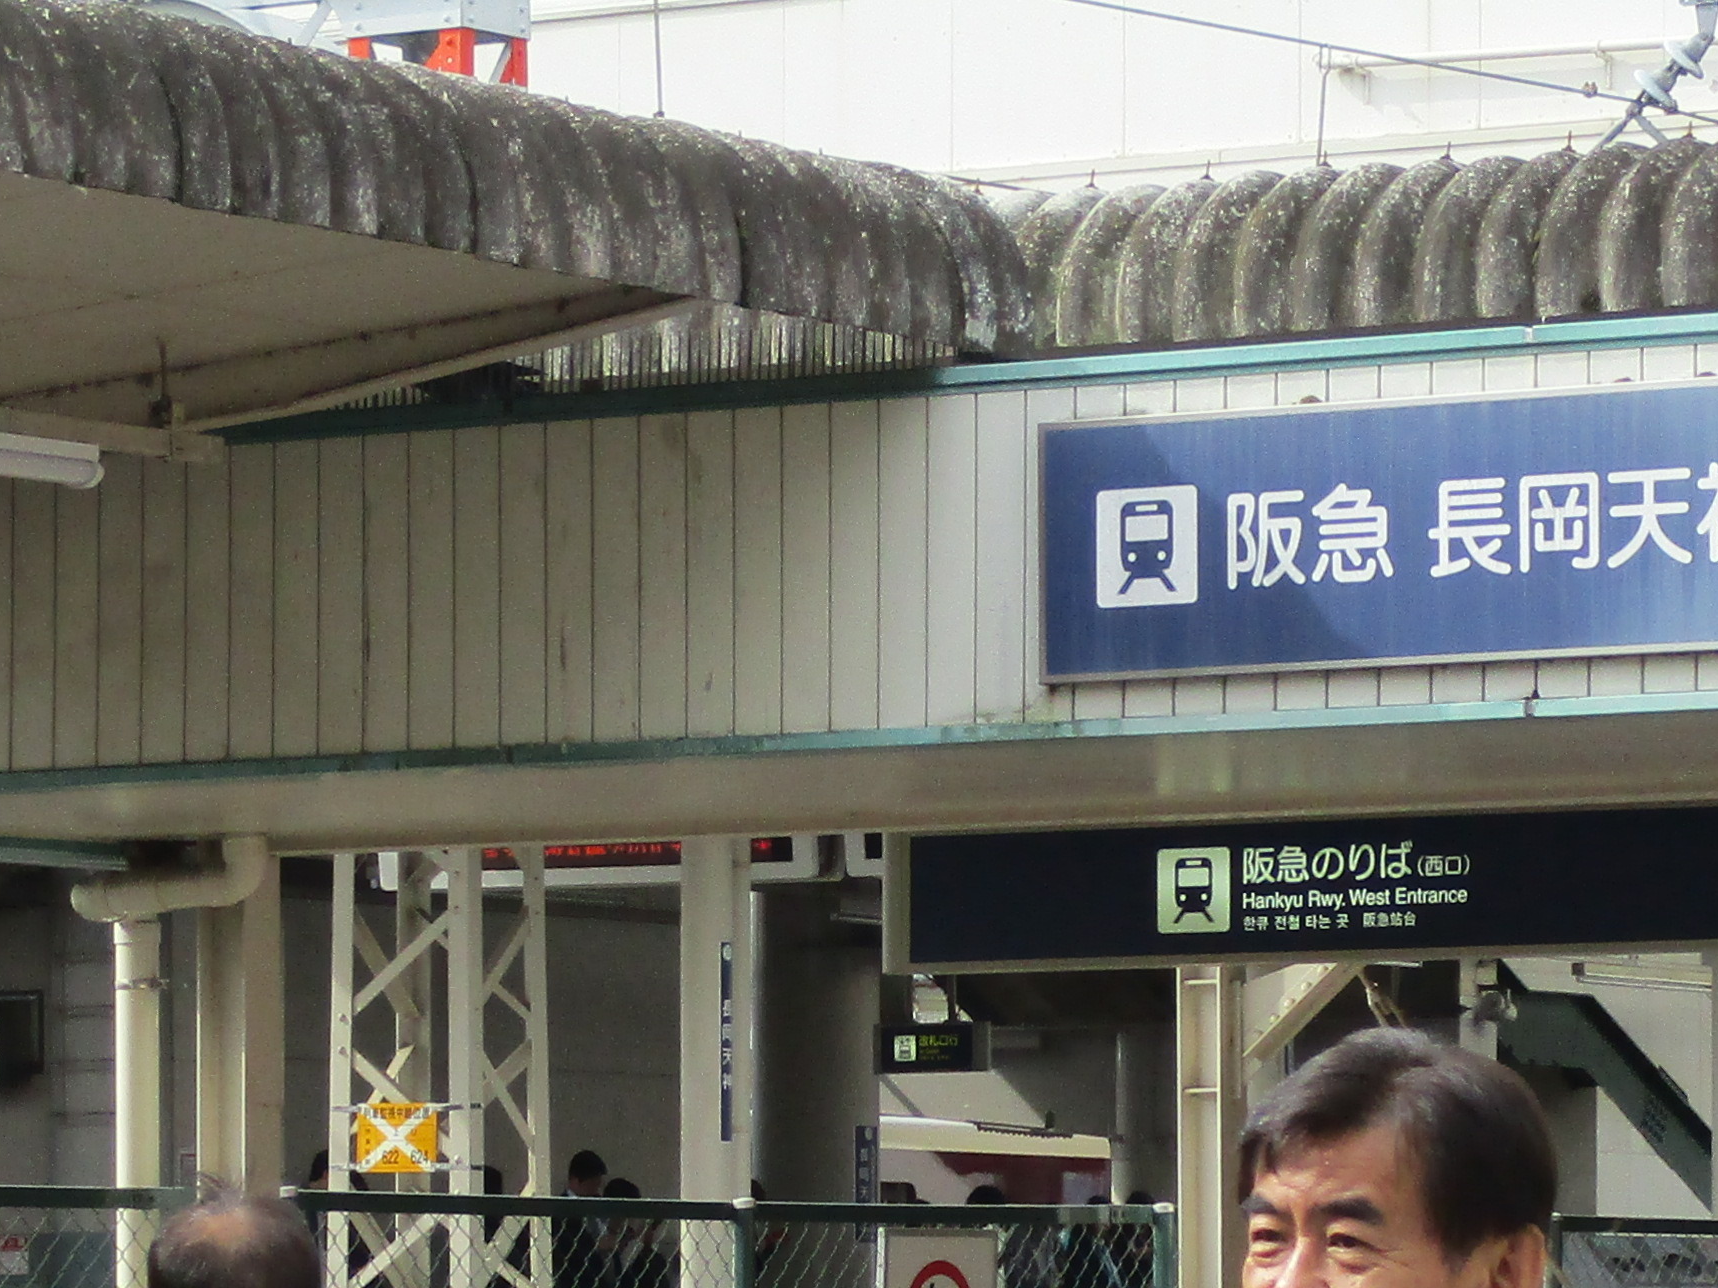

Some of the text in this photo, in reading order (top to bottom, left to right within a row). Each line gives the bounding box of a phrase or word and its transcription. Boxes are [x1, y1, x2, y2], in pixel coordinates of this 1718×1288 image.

[1227, 483, 1394, 590] 阪急
[1243, 840, 1414, 885] 阪急のりば
[1242, 886, 1468, 912] Hankyu Rwy. West Entrance
